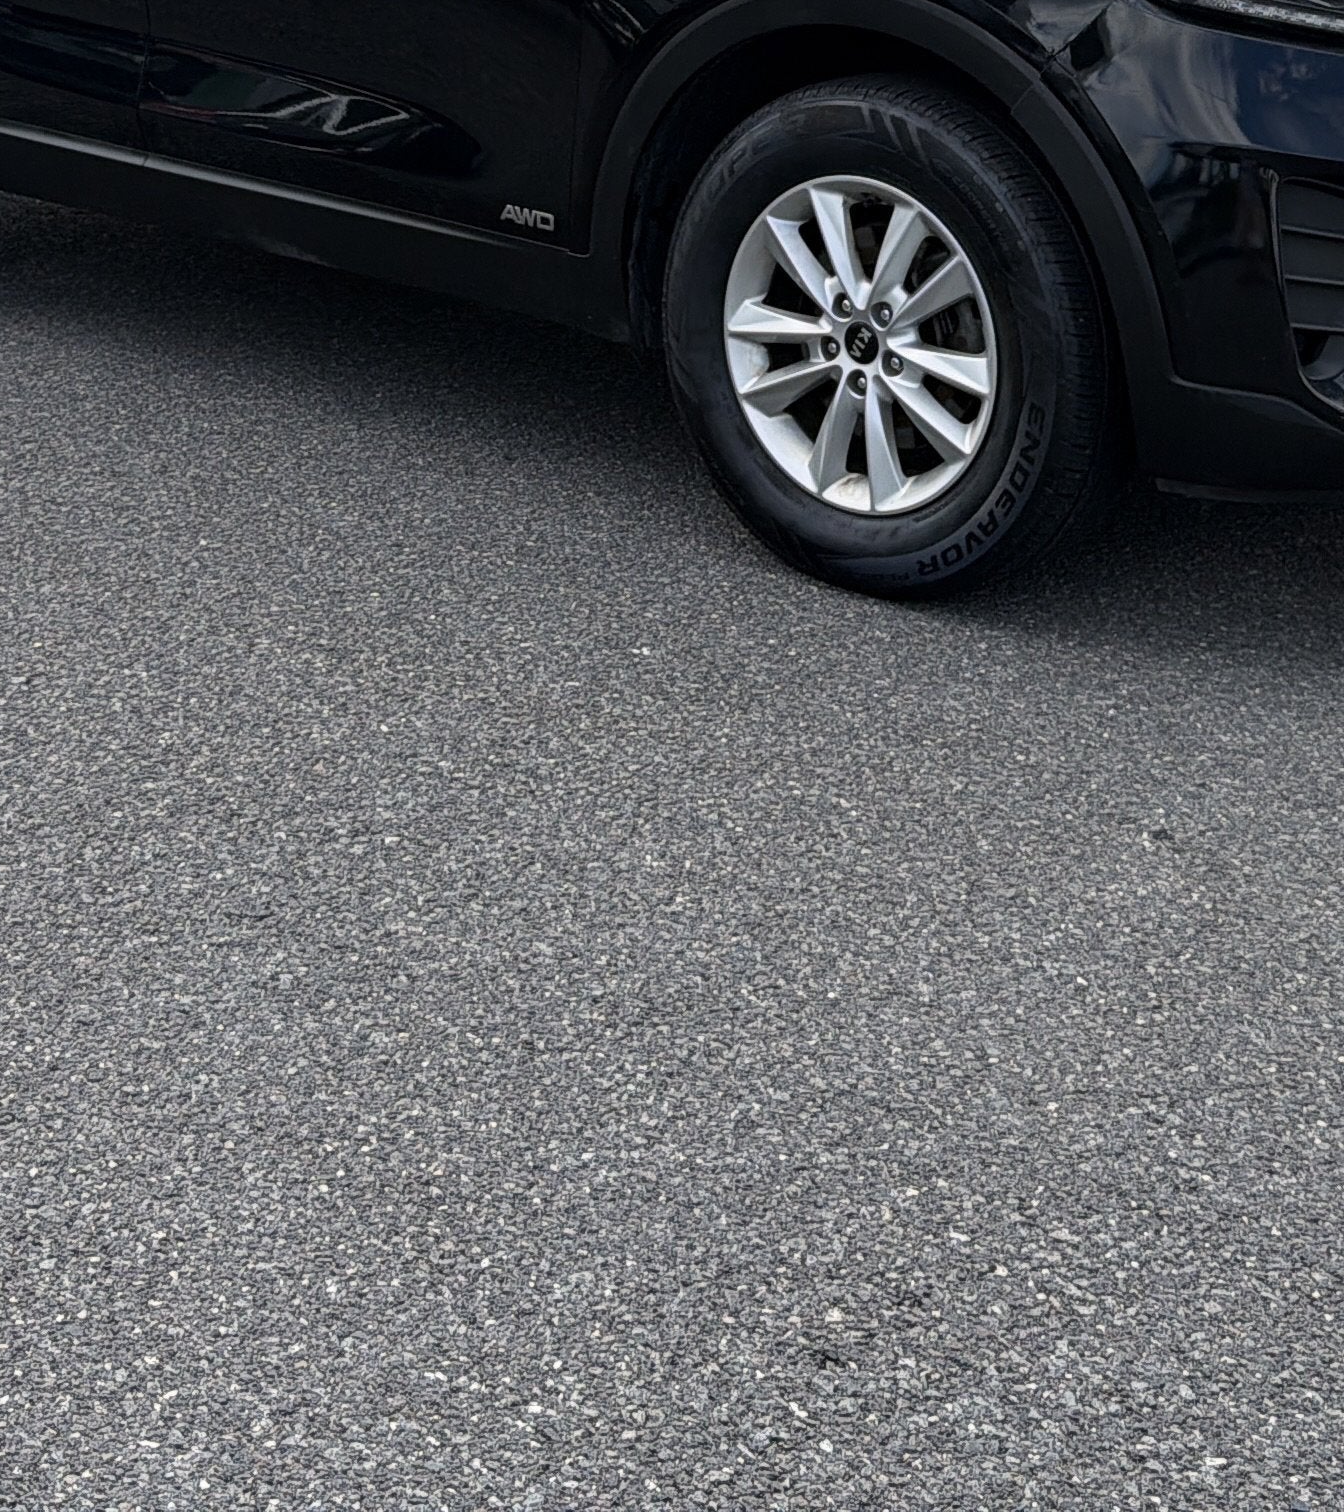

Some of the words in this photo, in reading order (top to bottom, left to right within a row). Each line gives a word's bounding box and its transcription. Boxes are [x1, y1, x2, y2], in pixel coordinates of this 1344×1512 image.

[500, 204, 554, 231] AWD
[849, 327, 872, 358] KIA
[915, 401, 1047, 577] ENDEAVOR
